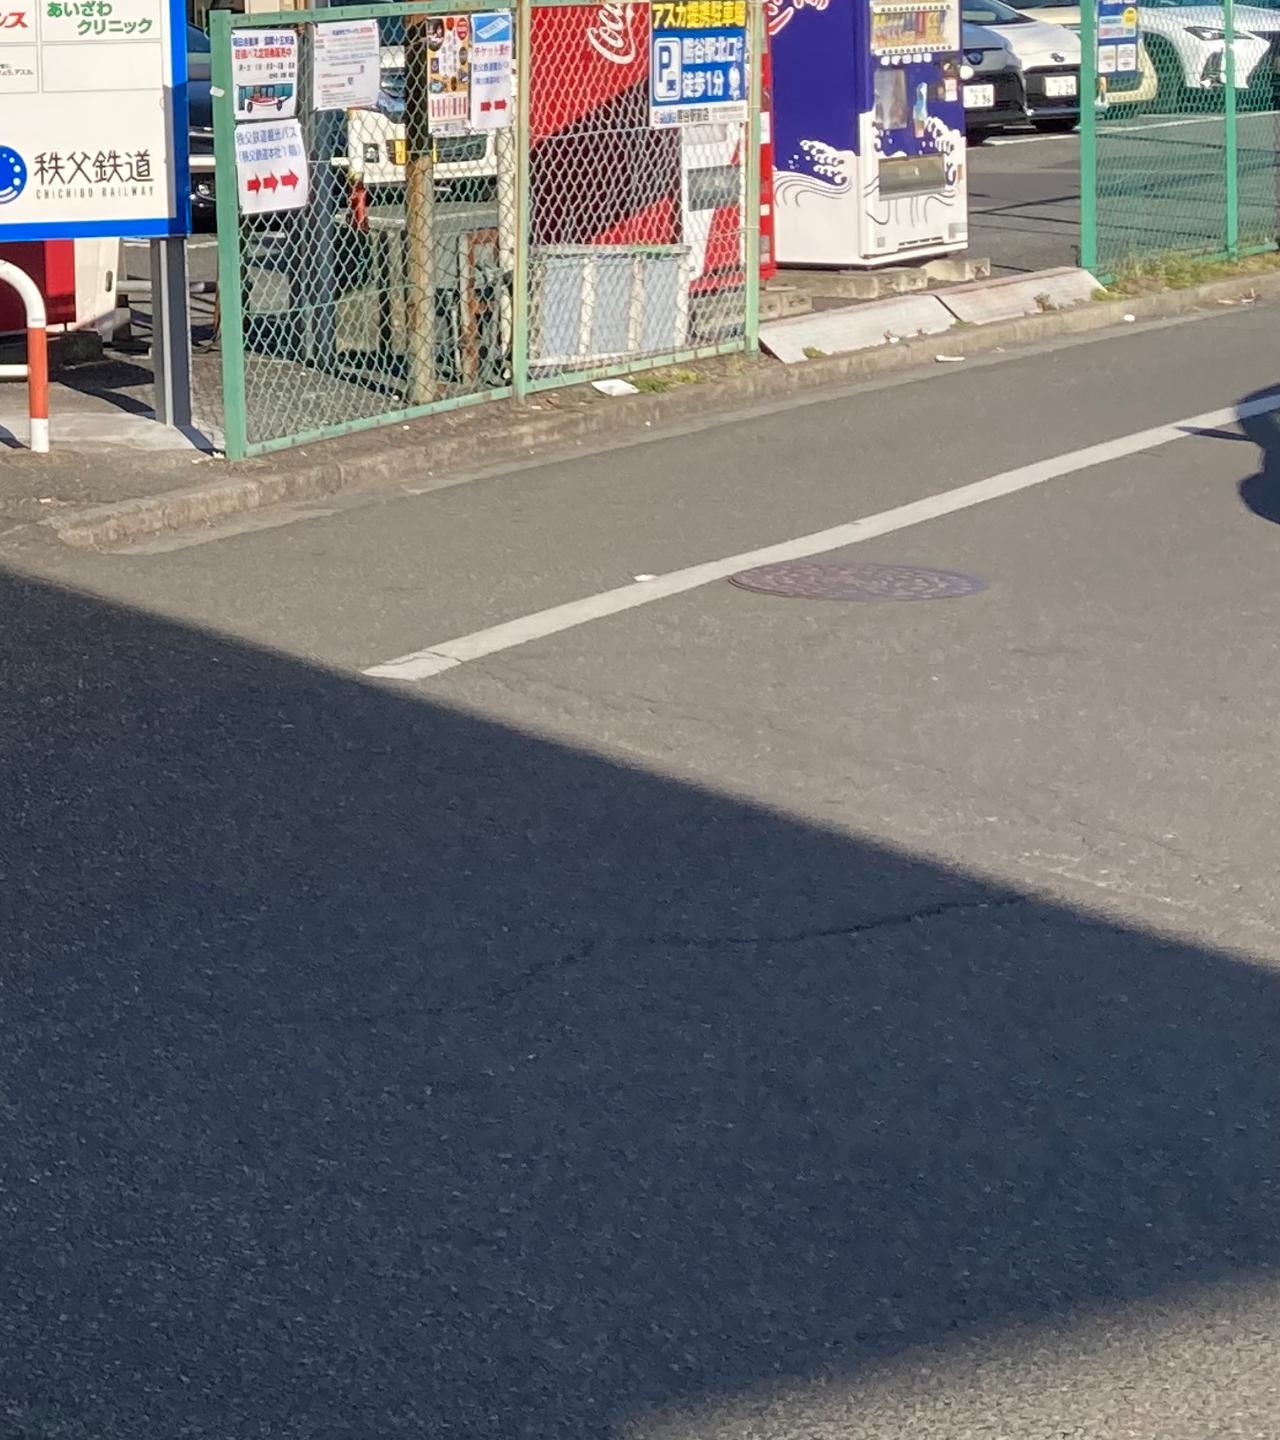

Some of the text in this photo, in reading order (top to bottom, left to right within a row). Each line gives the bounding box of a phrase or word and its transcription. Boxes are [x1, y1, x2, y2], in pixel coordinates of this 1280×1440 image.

[47, 1, 112, 17] あいざわ
[77, 18, 153, 35] クリニック
[34, 149, 154, 185] 秩父鉄道
[102, 186, 153, 197] RAILWAY
